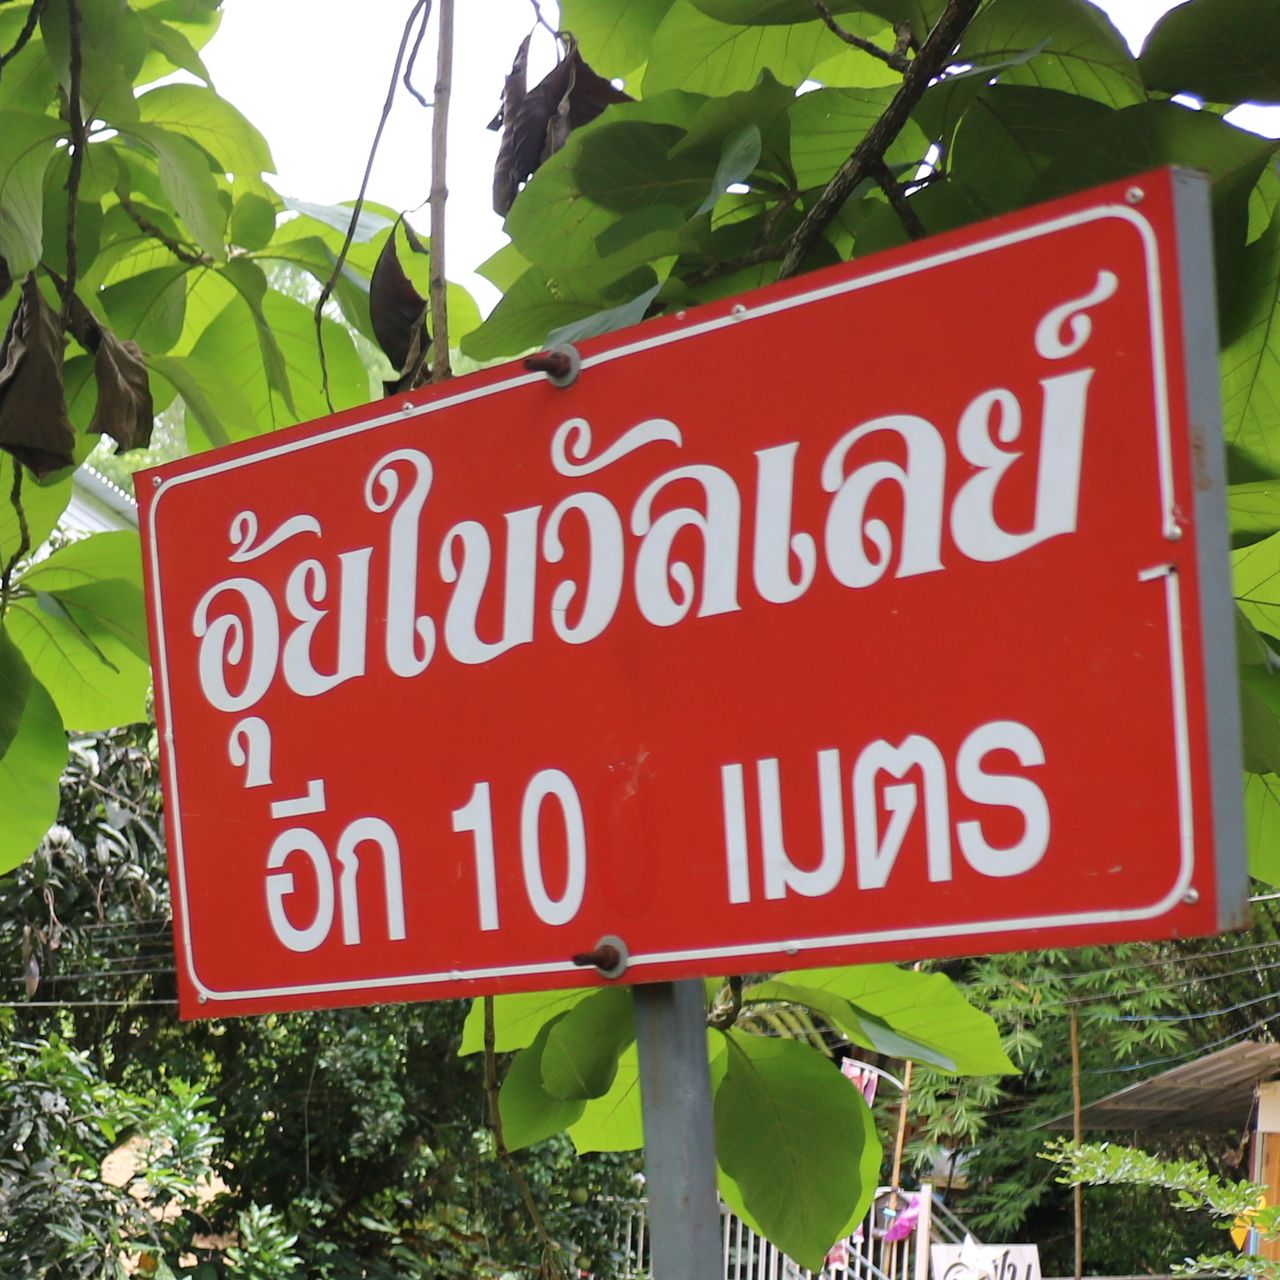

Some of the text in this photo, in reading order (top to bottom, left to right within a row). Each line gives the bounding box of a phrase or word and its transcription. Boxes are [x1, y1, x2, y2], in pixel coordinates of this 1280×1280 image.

[193, 271, 1117, 788] อุ้ยใบวัลเลย์
[266, 720, 1051, 953] อีก 10 เมตร
